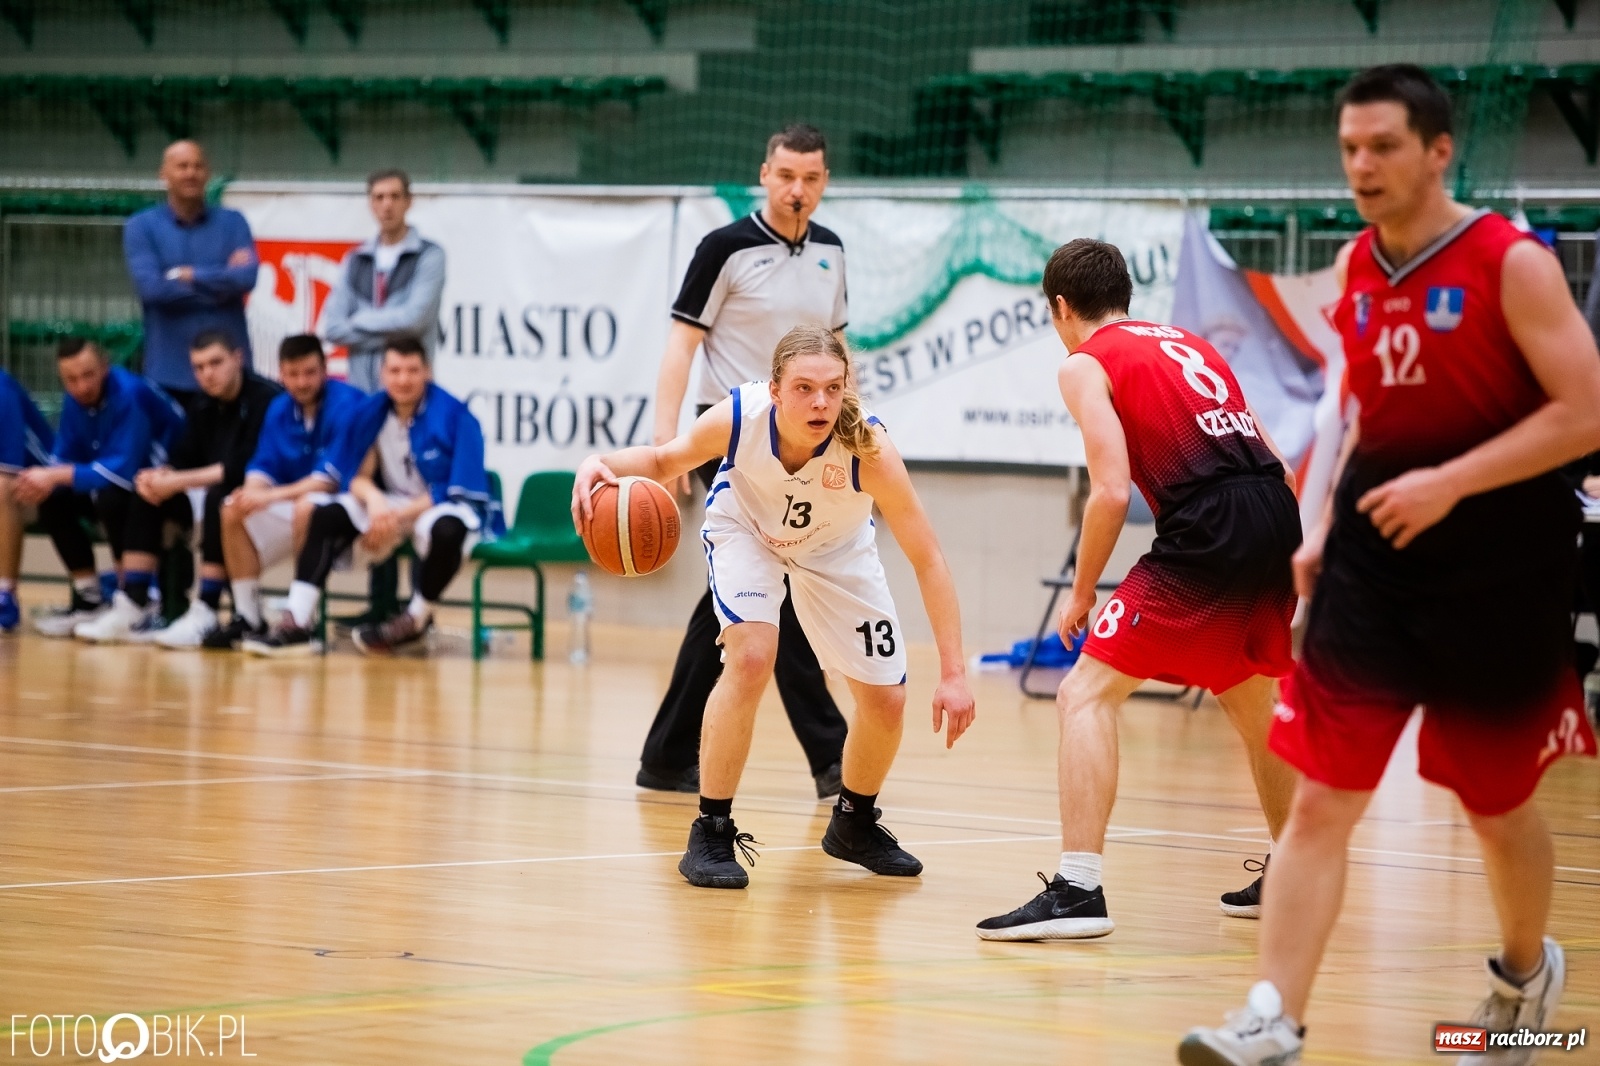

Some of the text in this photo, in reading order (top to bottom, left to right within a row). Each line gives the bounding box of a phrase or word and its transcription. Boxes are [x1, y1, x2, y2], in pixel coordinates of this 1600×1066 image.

[925, 328, 955, 370] W
[1373, 323, 1427, 387] 12
[1160, 340, 1230, 406] 8
[855, 619, 896, 658] 13
[1094, 599, 1126, 639] 8
